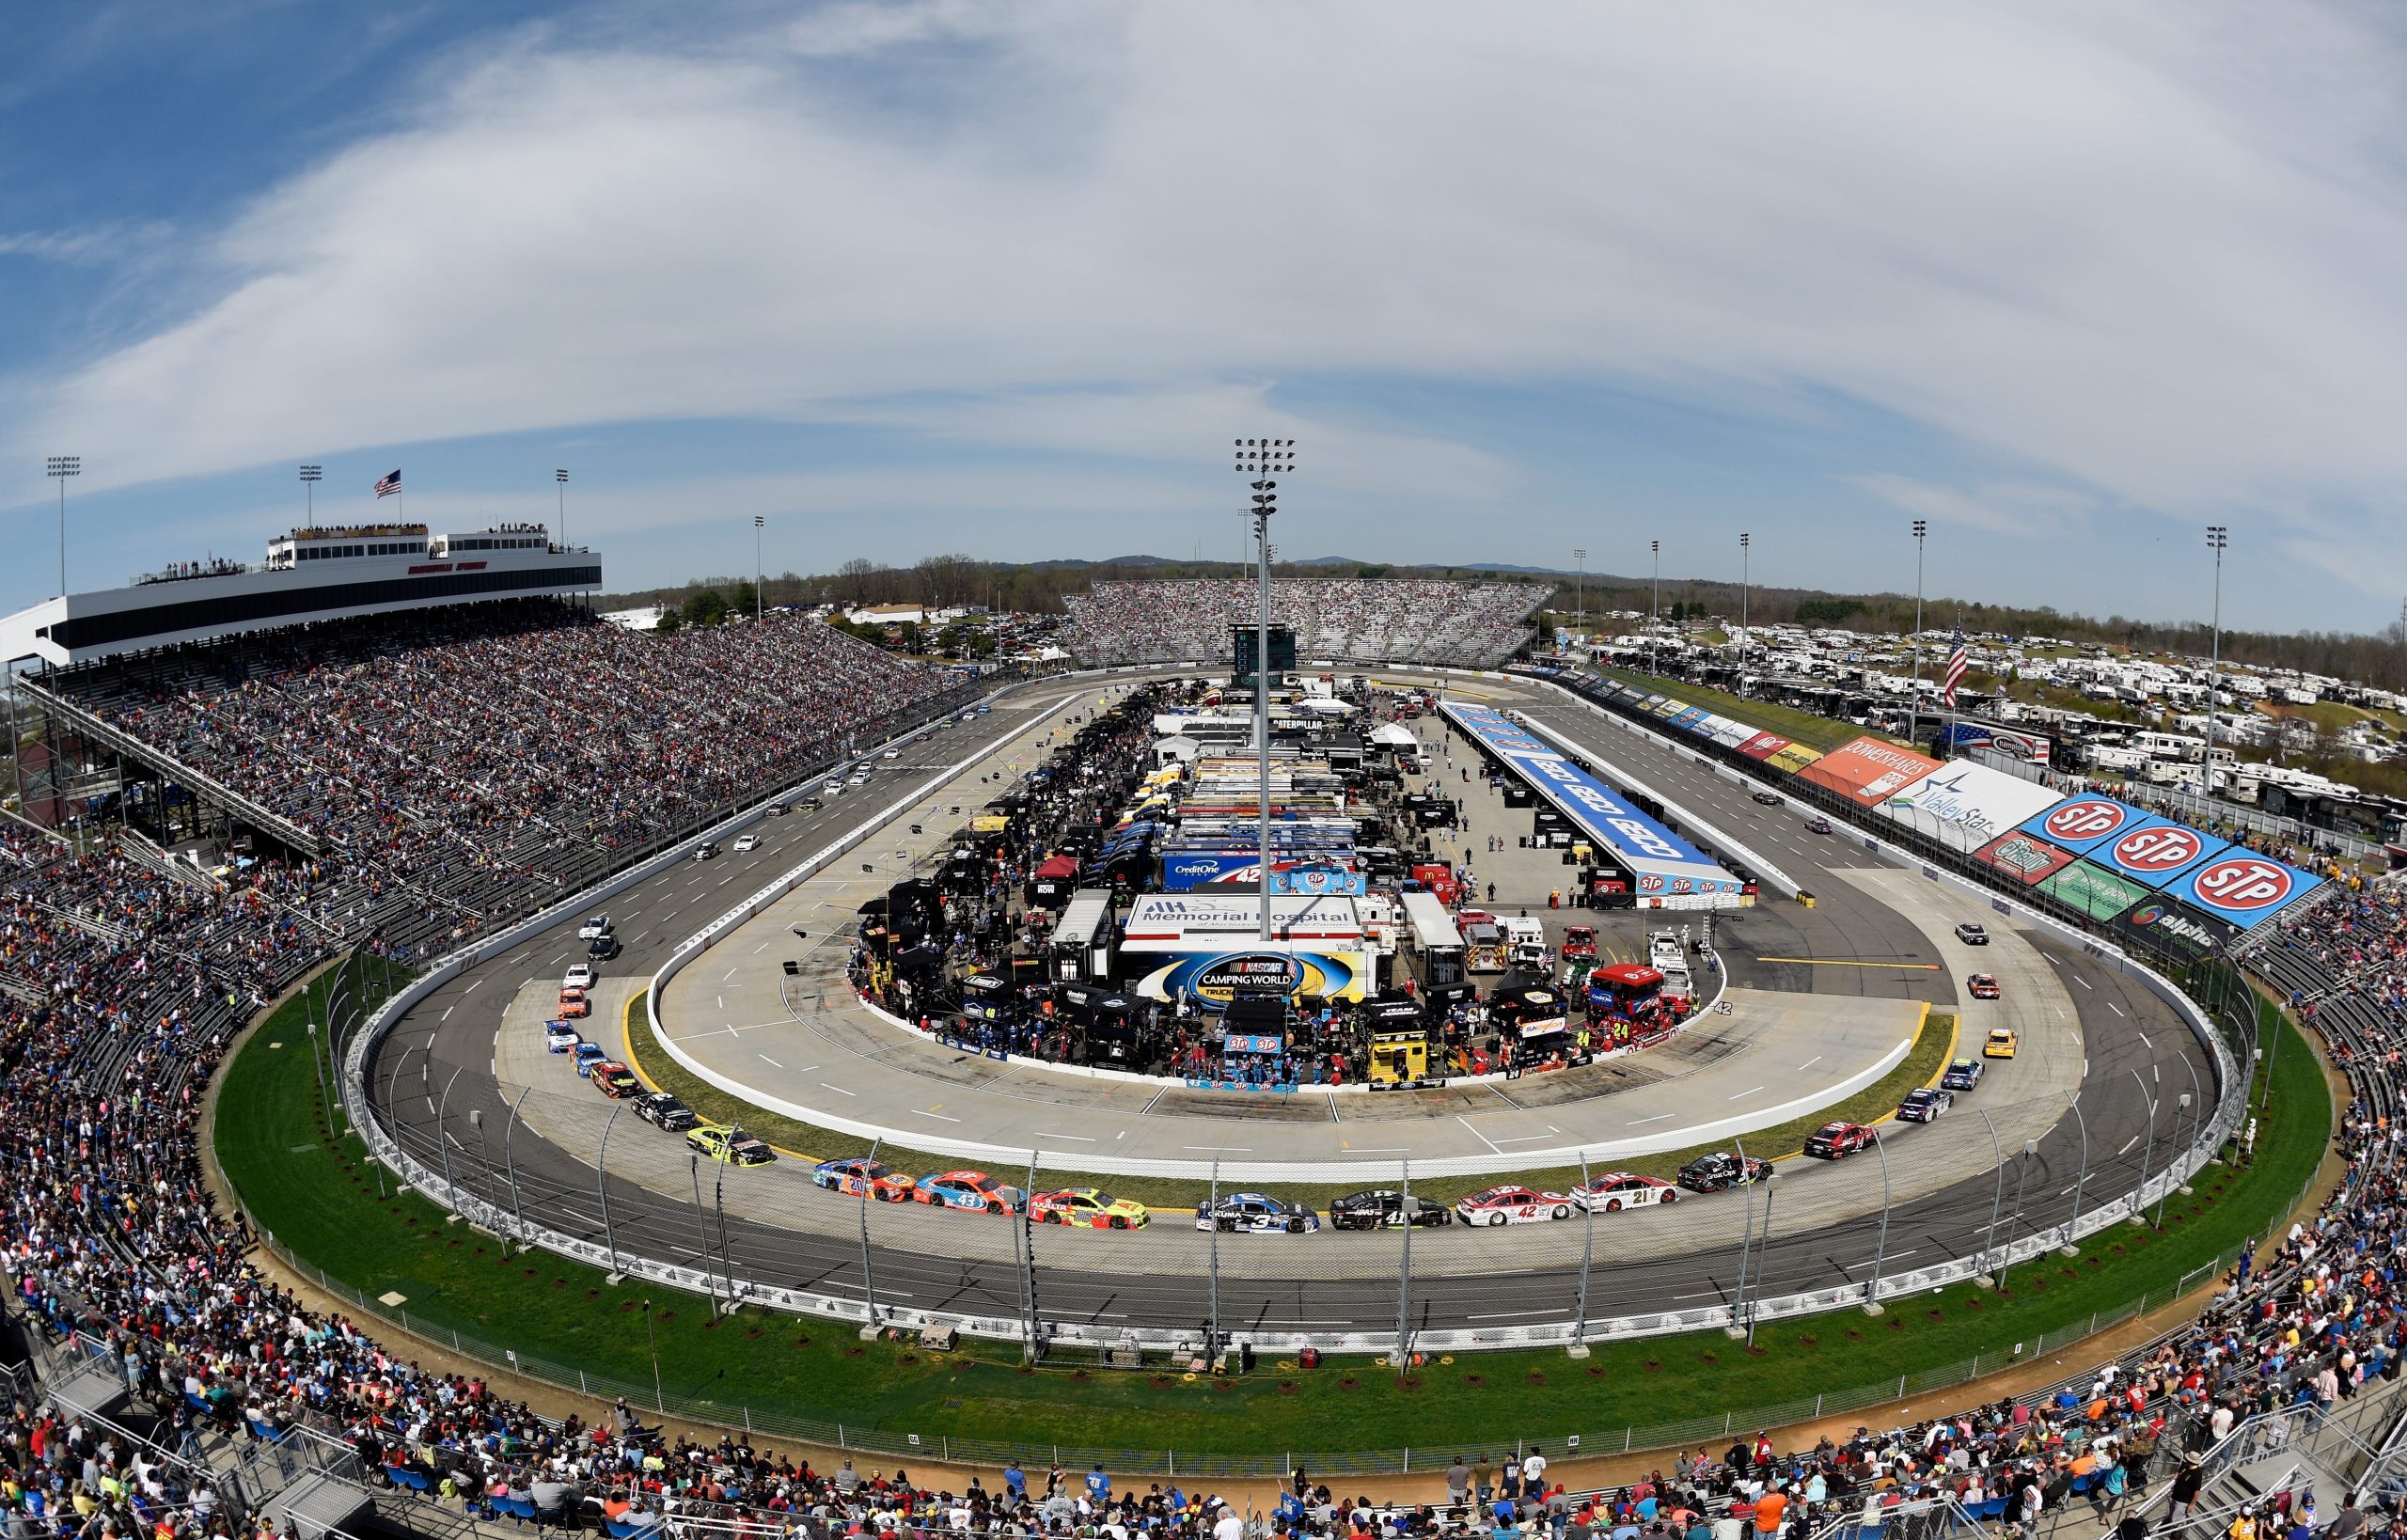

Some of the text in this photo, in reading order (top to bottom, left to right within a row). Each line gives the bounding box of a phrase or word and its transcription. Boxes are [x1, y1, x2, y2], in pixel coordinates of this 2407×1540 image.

[1273, 719, 1323, 730] CATERPILLAR
[1993, 735, 2025, 752] Champion
[1530, 759, 1581, 783] GEICO
[1564, 784, 1626, 815] GEICO
[1920, 792, 1994, 831] ValleyStar
[2052, 803, 2116, 834] STP
[1606, 817, 1684, 858] GEICO
[2120, 830, 2191, 863] STP
[1236, 869, 1261, 883] 42
[1309, 873, 1325, 883] STP
[1642, 876, 1662, 889] STP
[1674, 880, 1691, 890] STP
[1700, 882, 1715, 891] STP
[2202, 864, 2281, 902] STP
[1143, 912, 1248, 920] Memorial
[2159, 914, 2211, 948] alpha
[1246, 963, 1284, 972] NASCAR
[1203, 975, 1291, 985] CAMPING WORLD
[985, 1007, 996, 1018] 48
[1714, 1001, 1732, 1015] 42
[1613, 1023, 1628, 1039] 24
[1231, 1037, 1276, 1050] STP STP
[1577, 1031, 1590, 1046] 24
[1509, 1070, 1519, 1079] 24
[1235, 1082, 1248, 1091] STP
[713, 1142, 723, 1155] 27
[1855, 1136, 1864, 1149] 14
[1707, 1170, 1737, 1180] Great Clips
[850, 1177, 863, 1192] 20
[958, 1194, 976, 1207] 43
[1633, 1189, 1647, 1204] 21
[1030, 1201, 1067, 1211] AXALTA
[1518, 1205, 1536, 1218] 42
[1076, 1210, 1093, 1222] 88
[1250, 1214, 1271, 1230] 3
[1385, 1210, 1405, 1224] 41
[282, 1457, 295, 1476] GG
[1089, 1480, 1101, 1489] 48
[1189, 1504, 1202, 1513] 24
[2242, 1524, 2254, 1534] 32
